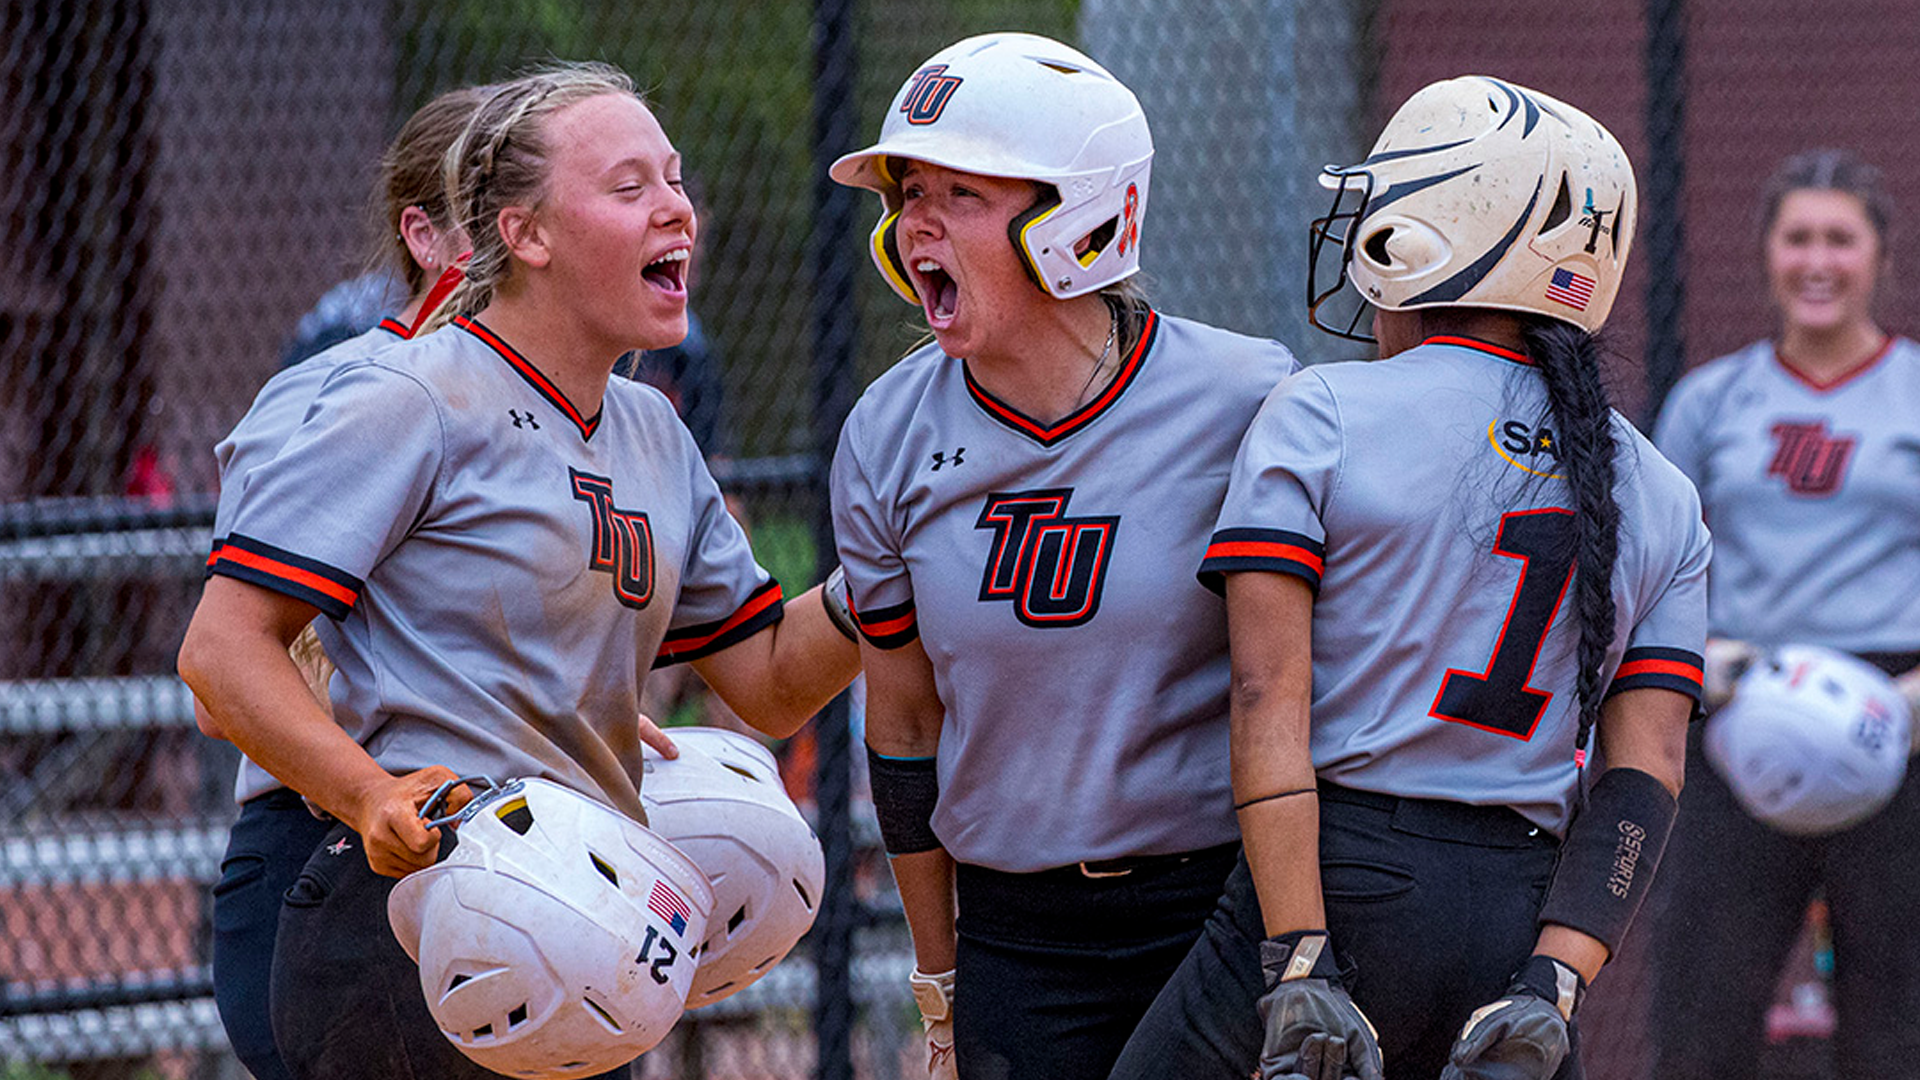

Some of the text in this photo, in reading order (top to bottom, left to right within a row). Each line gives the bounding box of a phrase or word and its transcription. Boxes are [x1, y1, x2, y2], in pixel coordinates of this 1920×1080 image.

[900, 64, 964, 125] TU
[1502, 420, 1561, 462] SA
[1768, 422, 1855, 495] TU
[568, 465, 656, 611] TU
[974, 487, 1121, 629] TU
[1427, 506, 1579, 742] 1
[635, 924, 678, 985] 21
